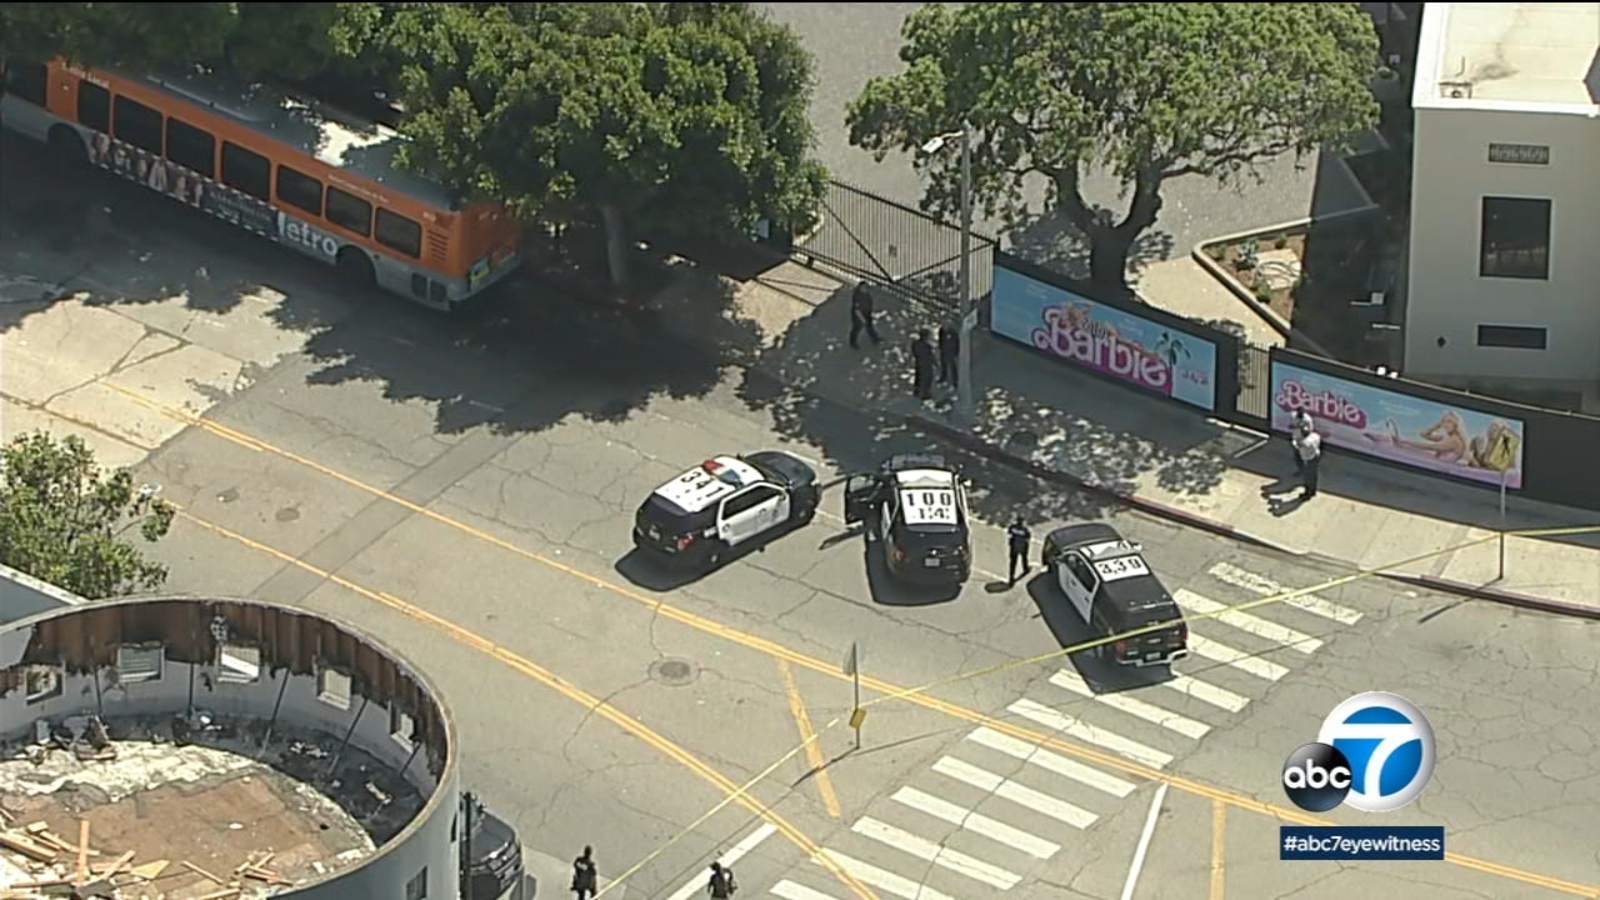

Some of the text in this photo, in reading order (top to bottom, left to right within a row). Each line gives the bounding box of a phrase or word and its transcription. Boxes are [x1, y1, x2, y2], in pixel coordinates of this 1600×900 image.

[1032, 308, 1167, 387] Barbie
[1276, 381, 1361, 423] Barbie
[906, 492, 951, 506] 100
[1098, 558, 1142, 575] 339
